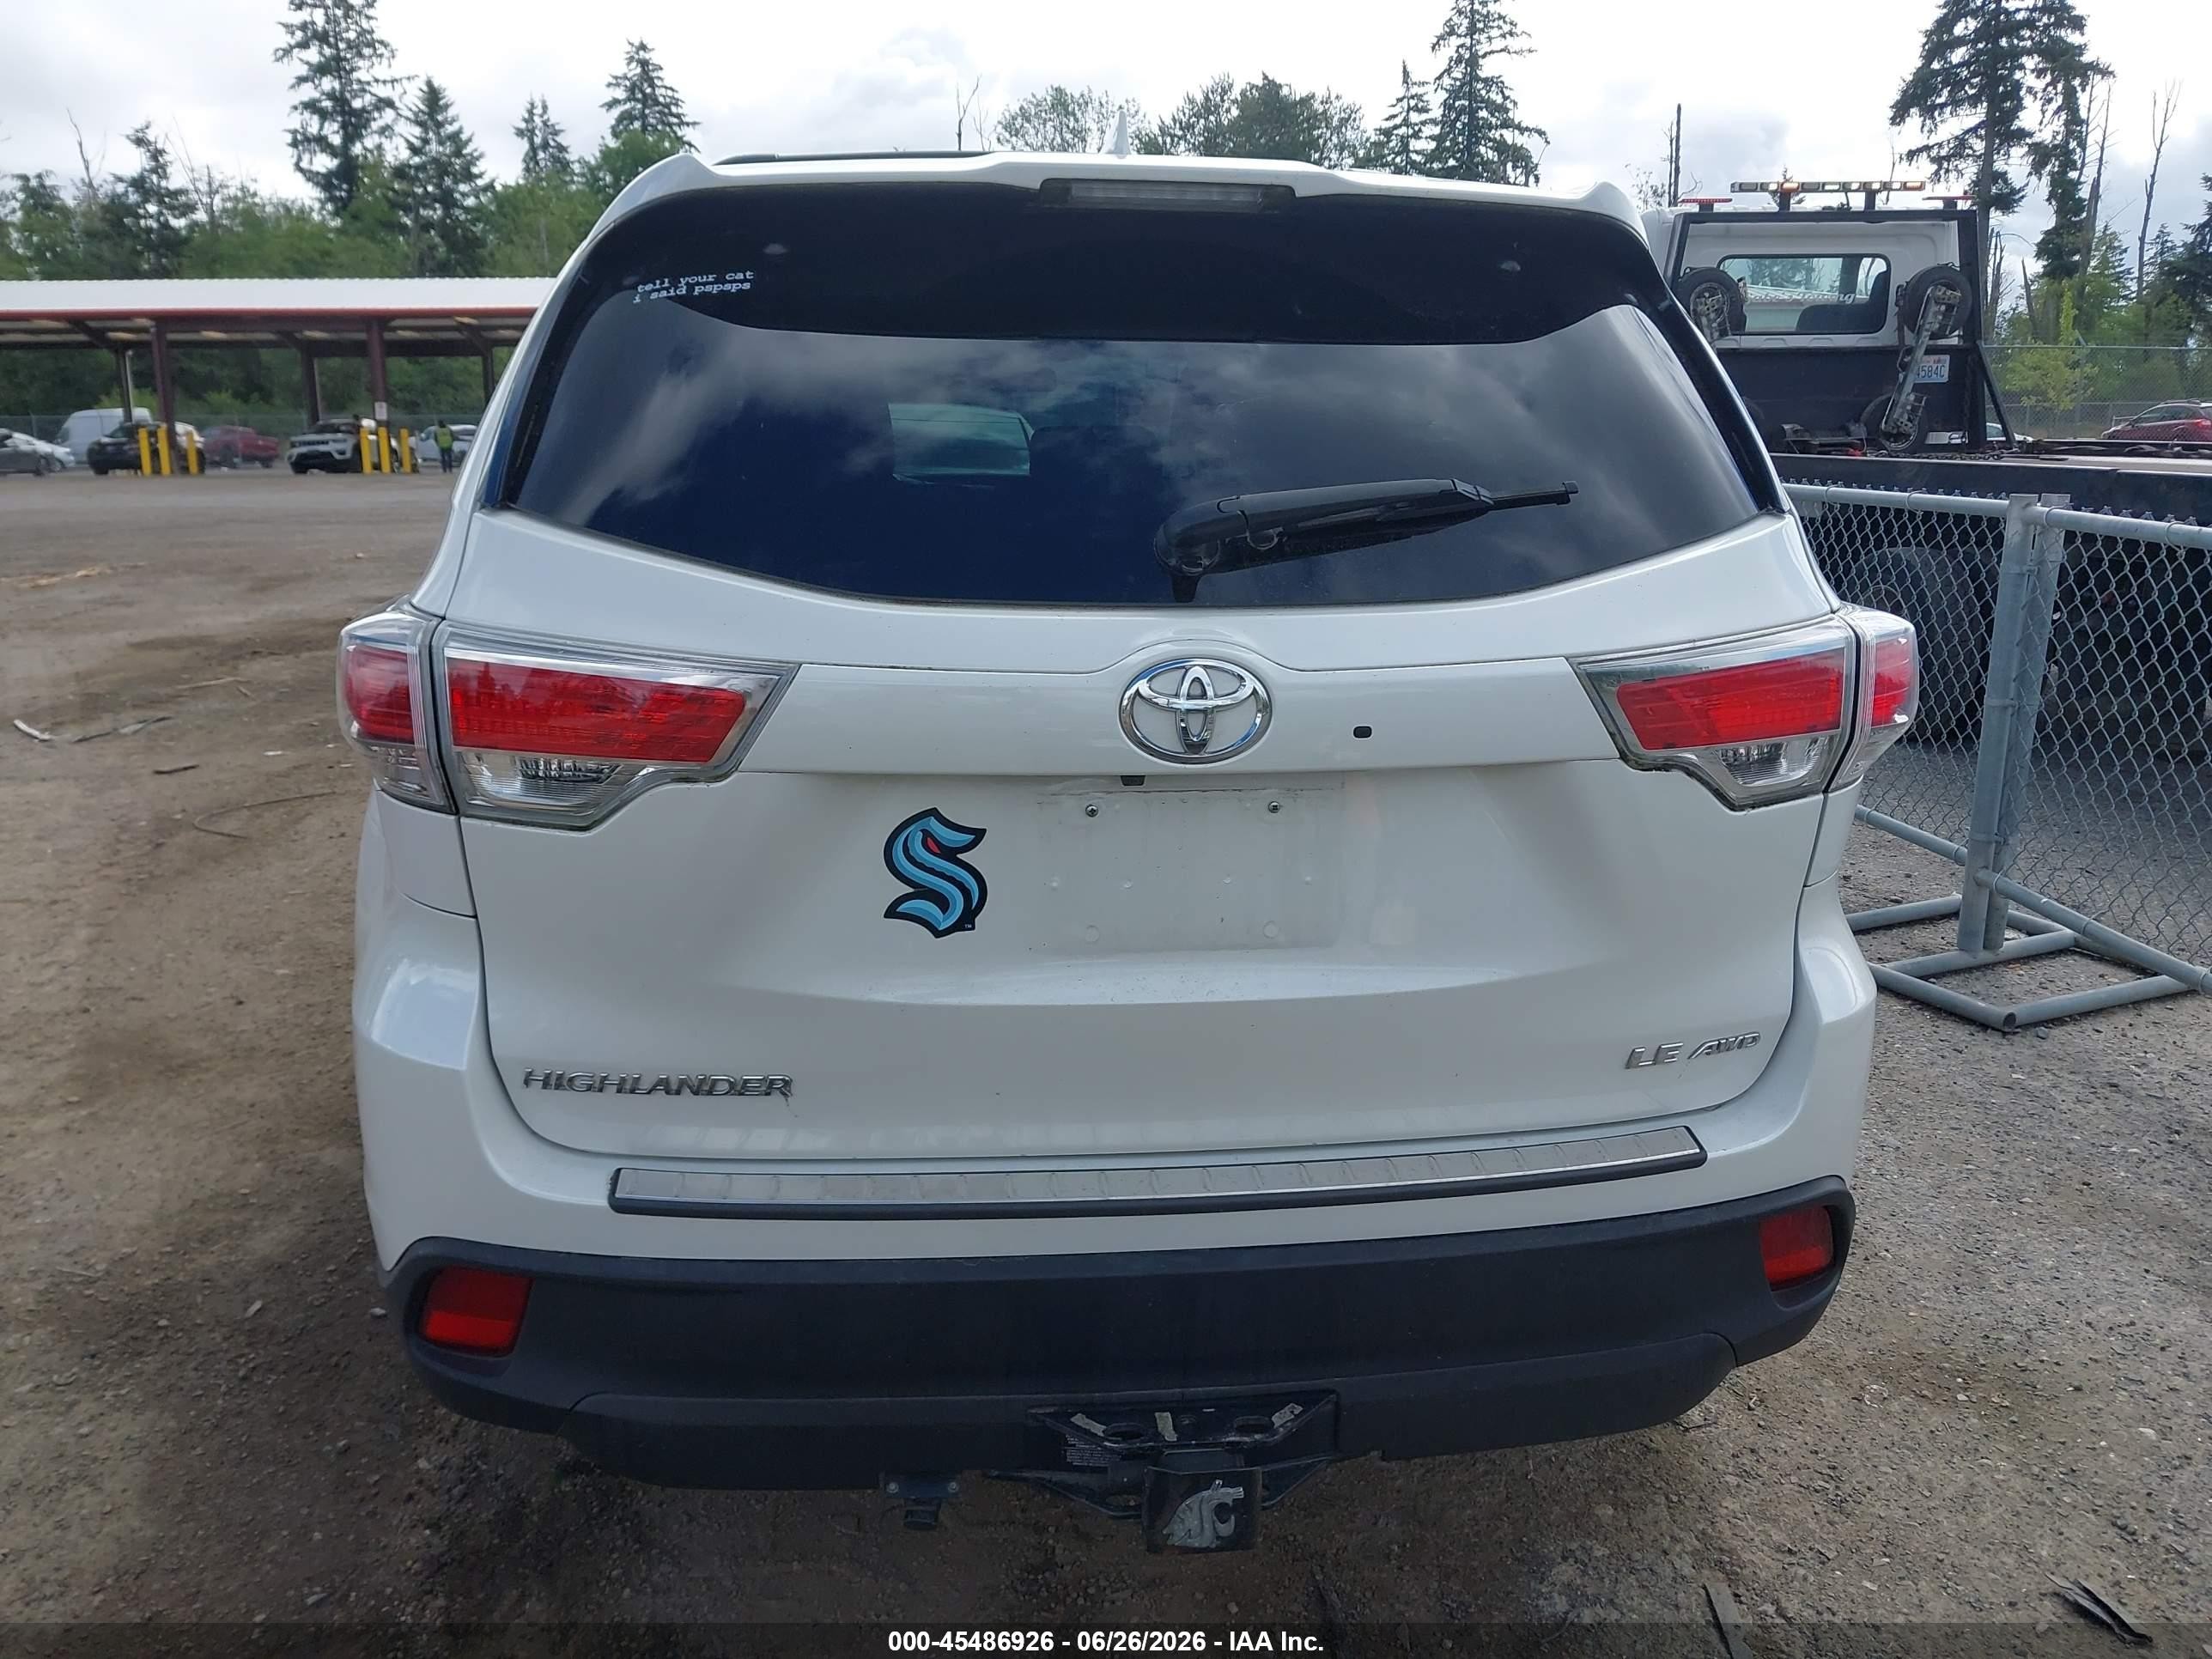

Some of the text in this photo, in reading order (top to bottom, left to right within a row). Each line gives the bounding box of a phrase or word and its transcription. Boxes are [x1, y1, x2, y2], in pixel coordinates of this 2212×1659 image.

[637, 270, 755, 293] tell your cat
[649, 284, 687, 300] said
[693, 282, 752, 295] pspsps
[1625, 1031, 1760, 1070] LE AWD
[522, 1067, 794, 1097] HIGHLANDER
